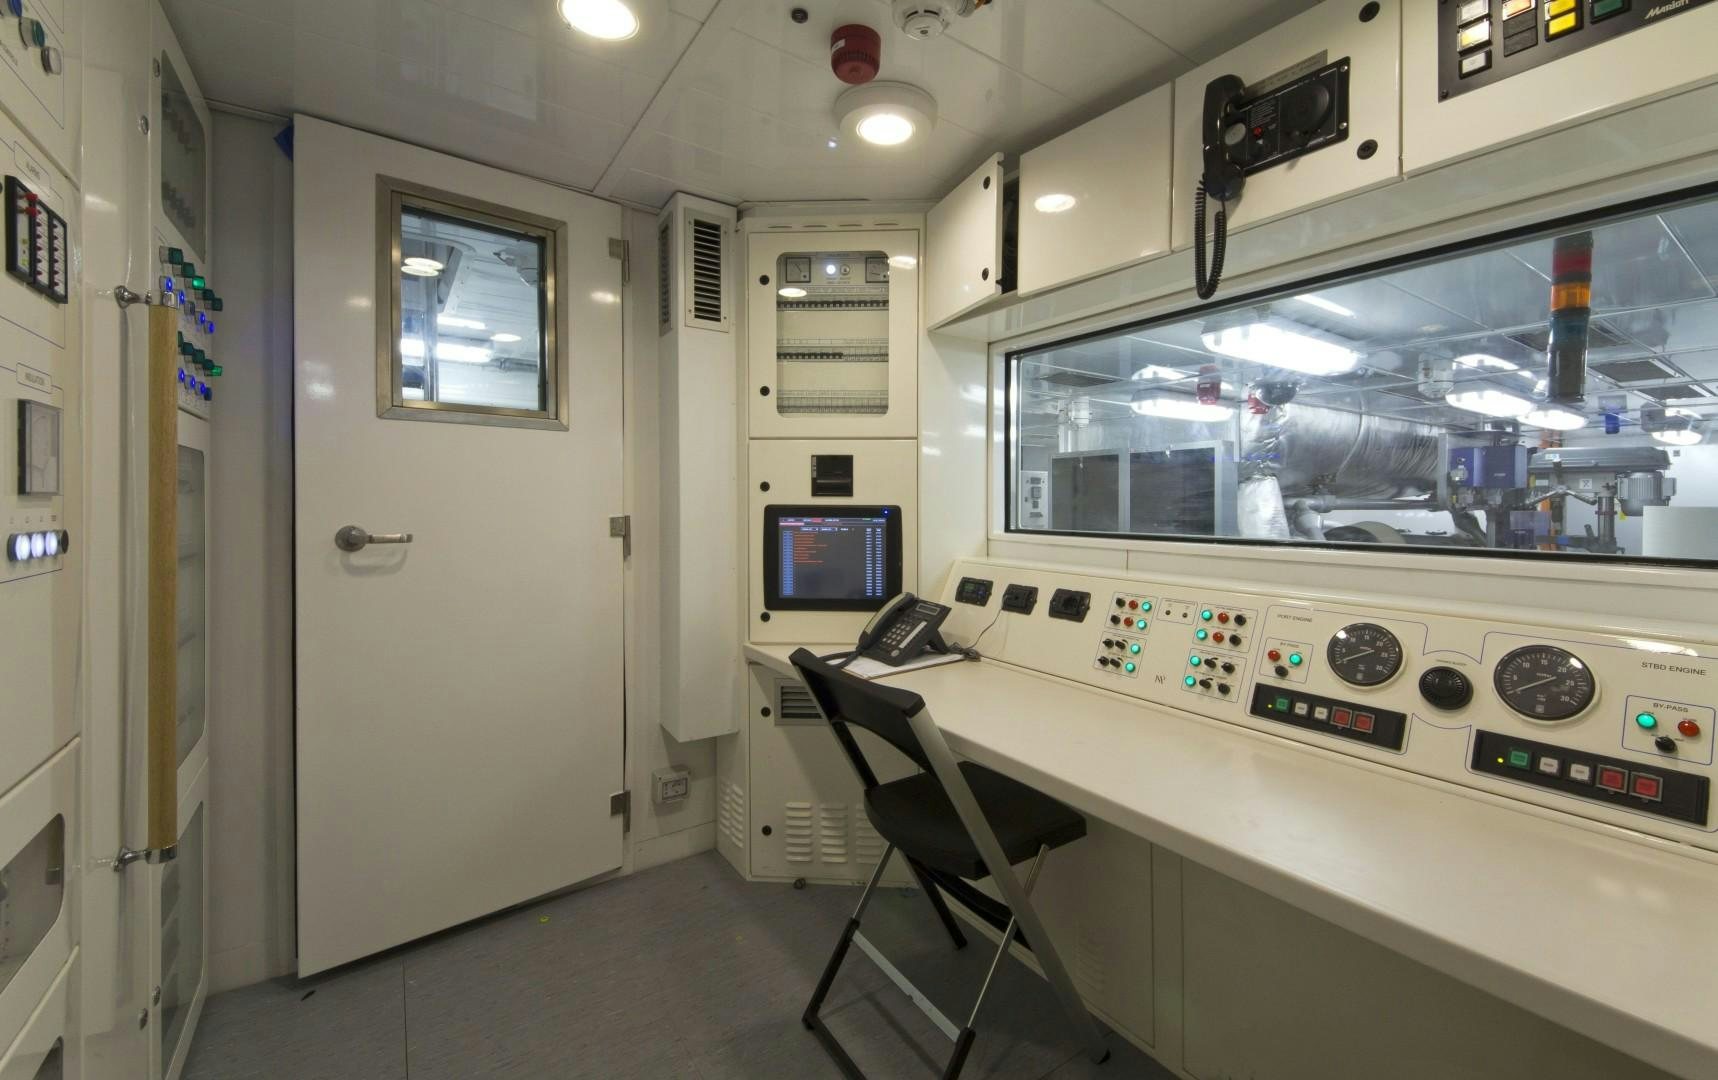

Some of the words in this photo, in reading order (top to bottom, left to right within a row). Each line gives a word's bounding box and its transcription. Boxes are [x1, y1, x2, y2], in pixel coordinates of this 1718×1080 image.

[1641, 661, 1667, 671] STBD
[1669, 665, 1707, 676] ENGINE
[1652, 702, 1689, 713] BY-PASS
